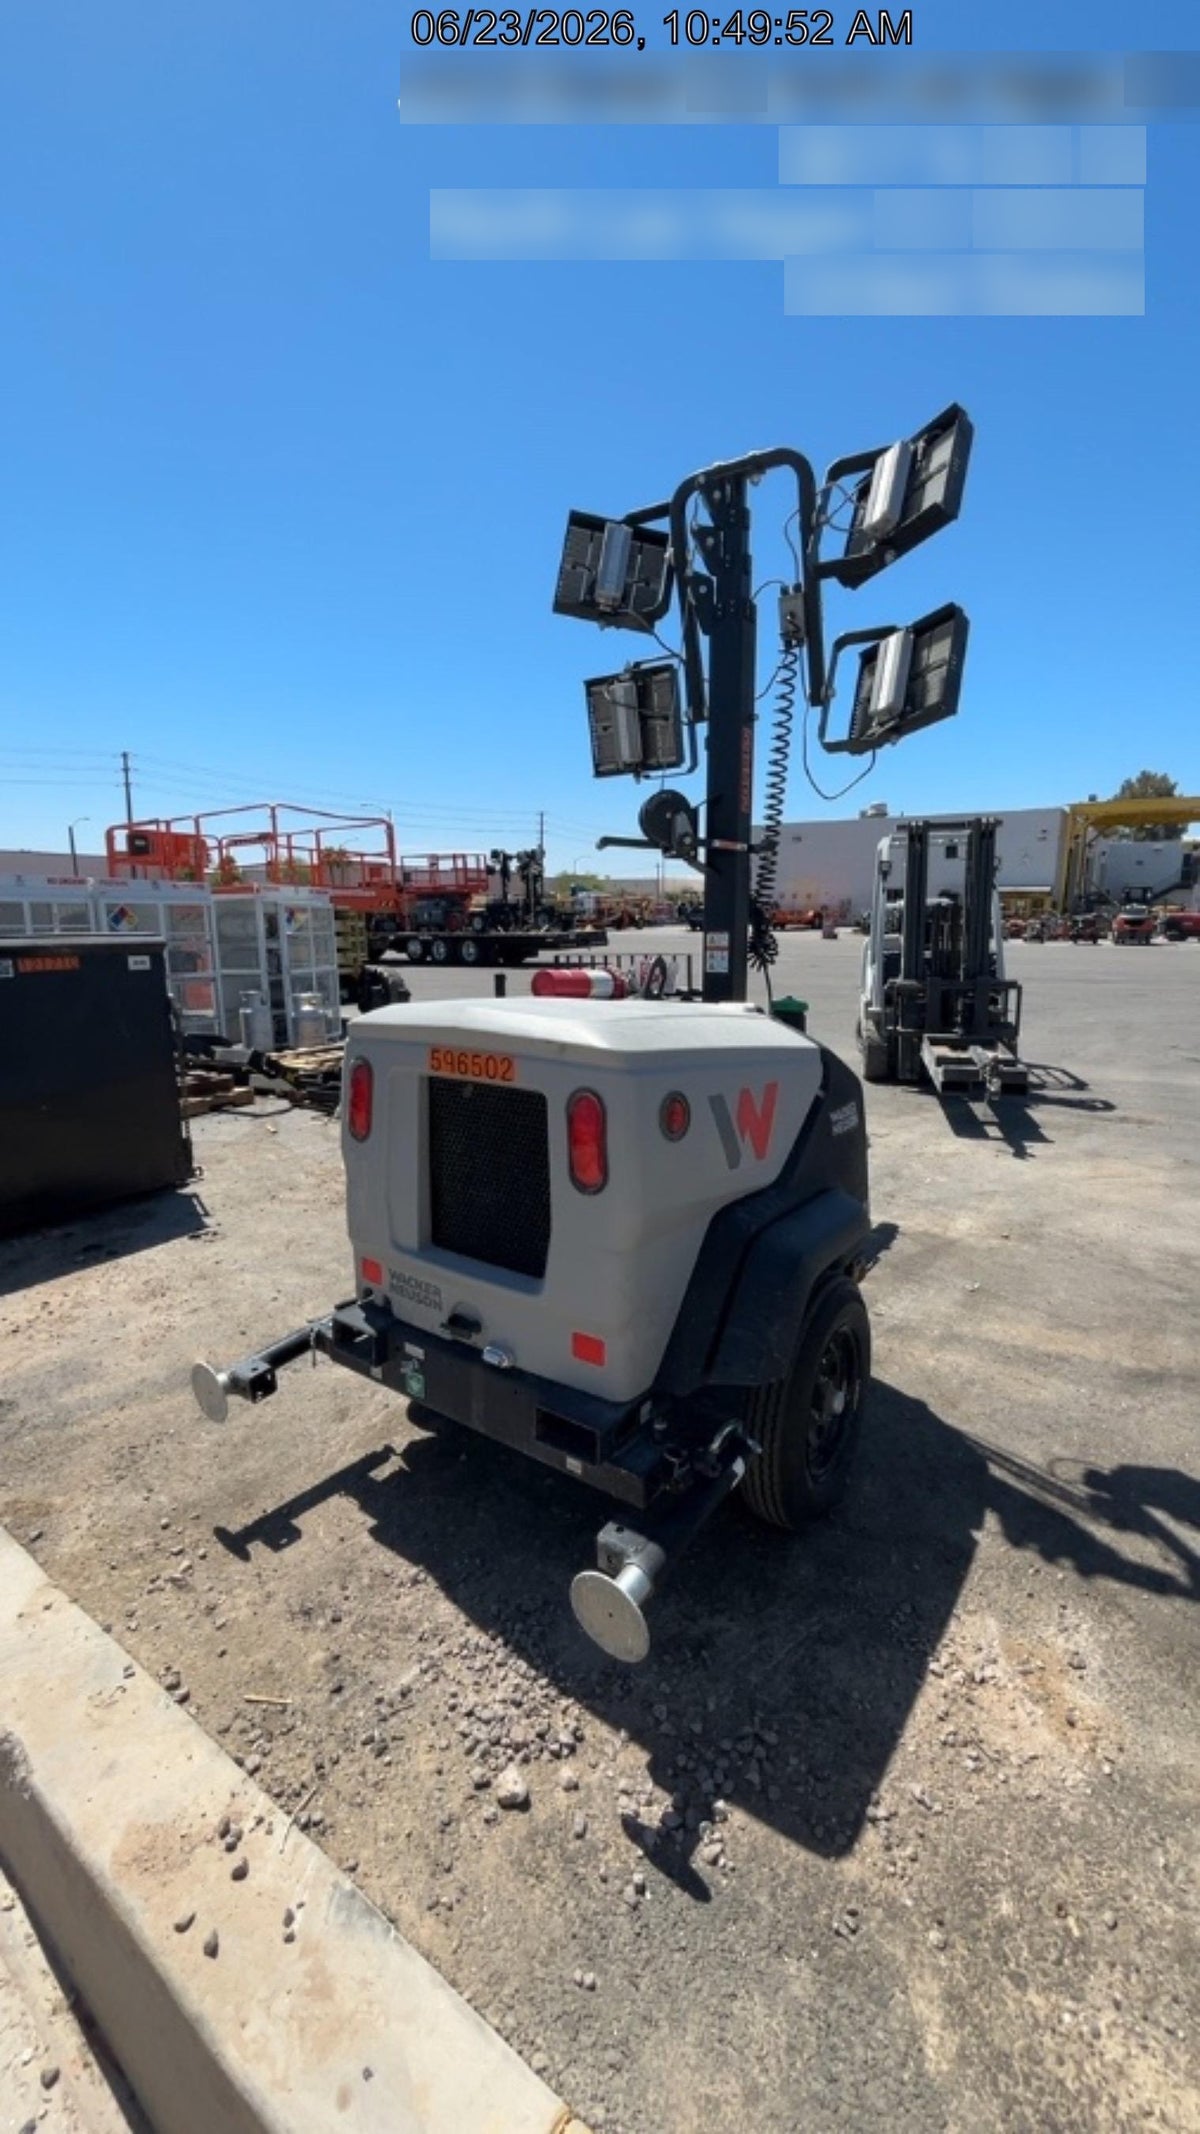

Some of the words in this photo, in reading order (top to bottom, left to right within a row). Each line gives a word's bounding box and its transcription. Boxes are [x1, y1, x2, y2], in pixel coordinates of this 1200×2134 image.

[430, 1047, 514, 1082] 596502
[388, 1268, 442, 1299] WACKER
[389, 1282, 442, 1311] NEUSON
